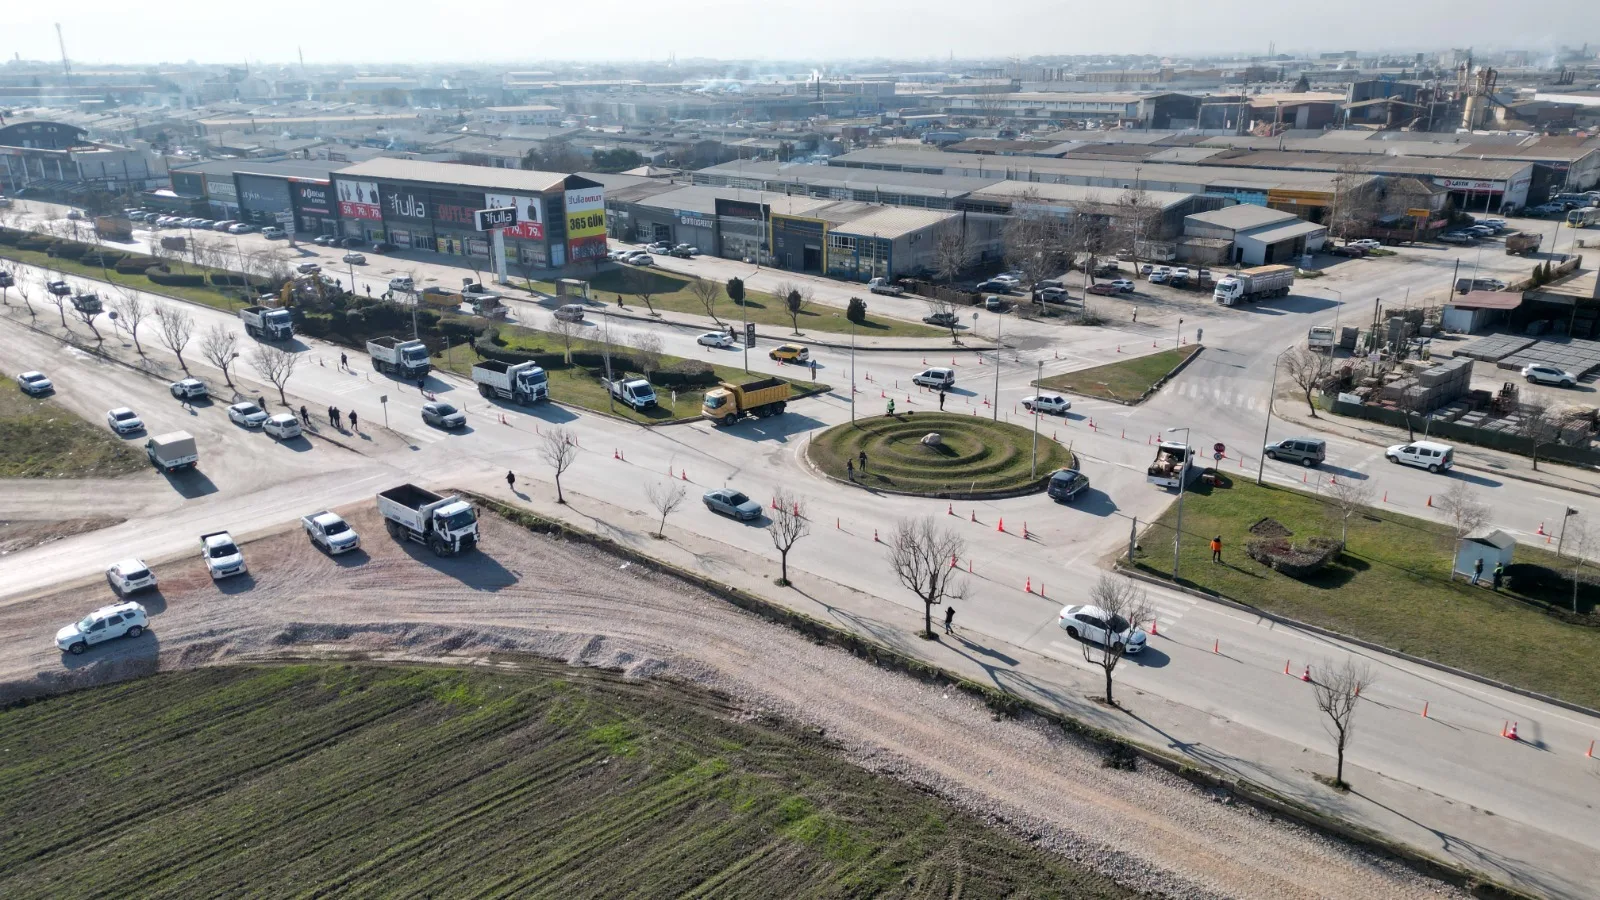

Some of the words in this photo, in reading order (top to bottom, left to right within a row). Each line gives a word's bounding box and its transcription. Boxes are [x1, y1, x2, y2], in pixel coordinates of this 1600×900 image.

[394, 193, 426, 218] fulla
[570, 217, 586, 230] 365
[587, 213, 604, 228] GÜN
